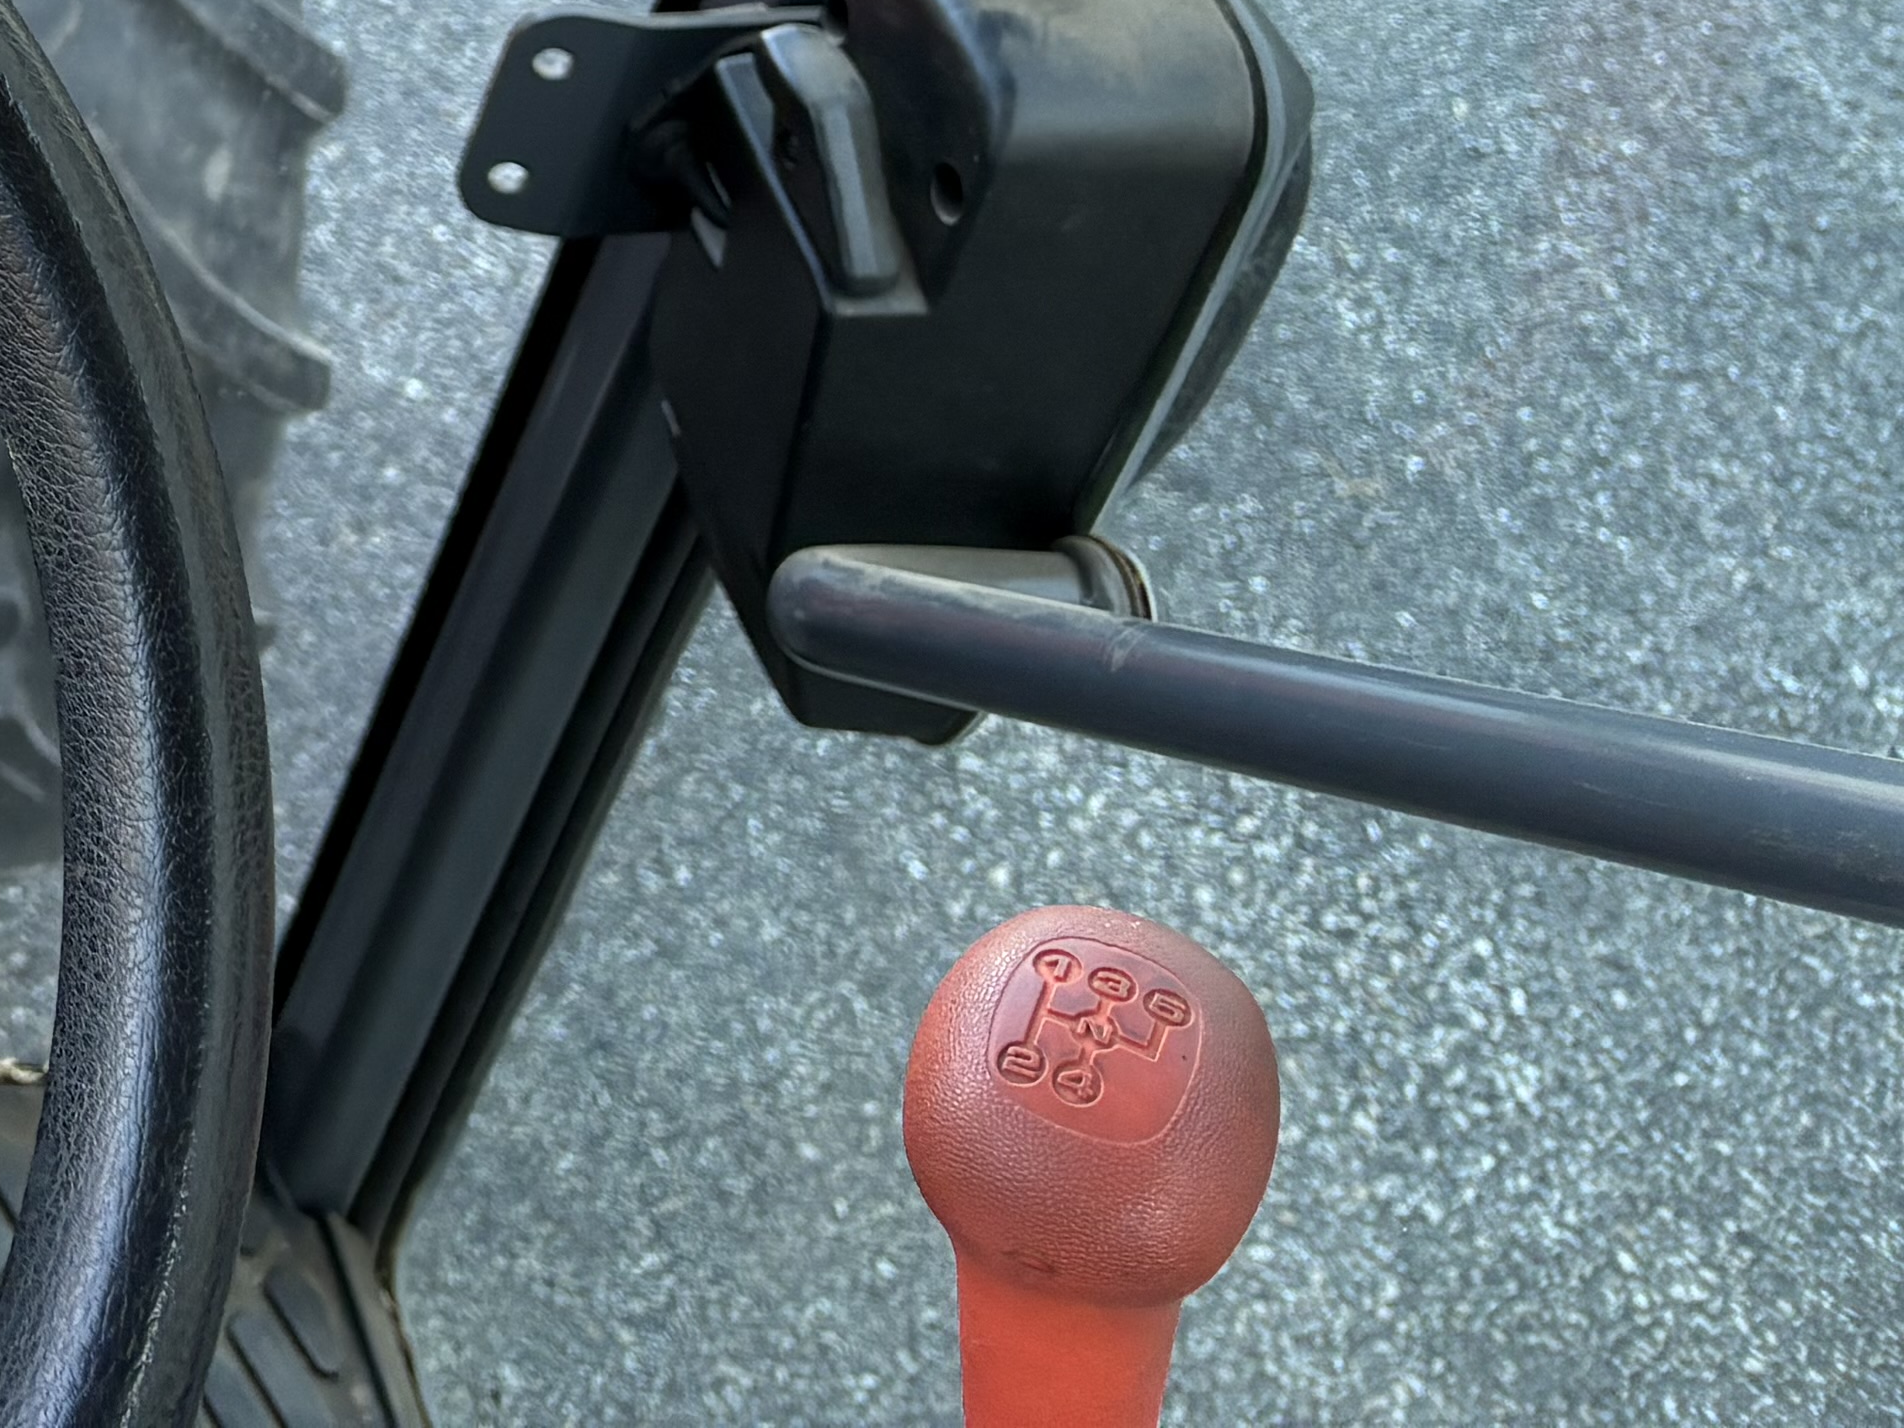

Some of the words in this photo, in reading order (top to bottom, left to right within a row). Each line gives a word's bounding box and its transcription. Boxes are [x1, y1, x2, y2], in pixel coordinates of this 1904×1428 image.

[1043, 954, 1072, 981] 1
[1092, 970, 1132, 998] 3
[1148, 991, 1187, 1023] 5
[1076, 1017, 1113, 1045] N
[1001, 1045, 1042, 1079] 2
[1056, 1069, 1094, 1102] 4
